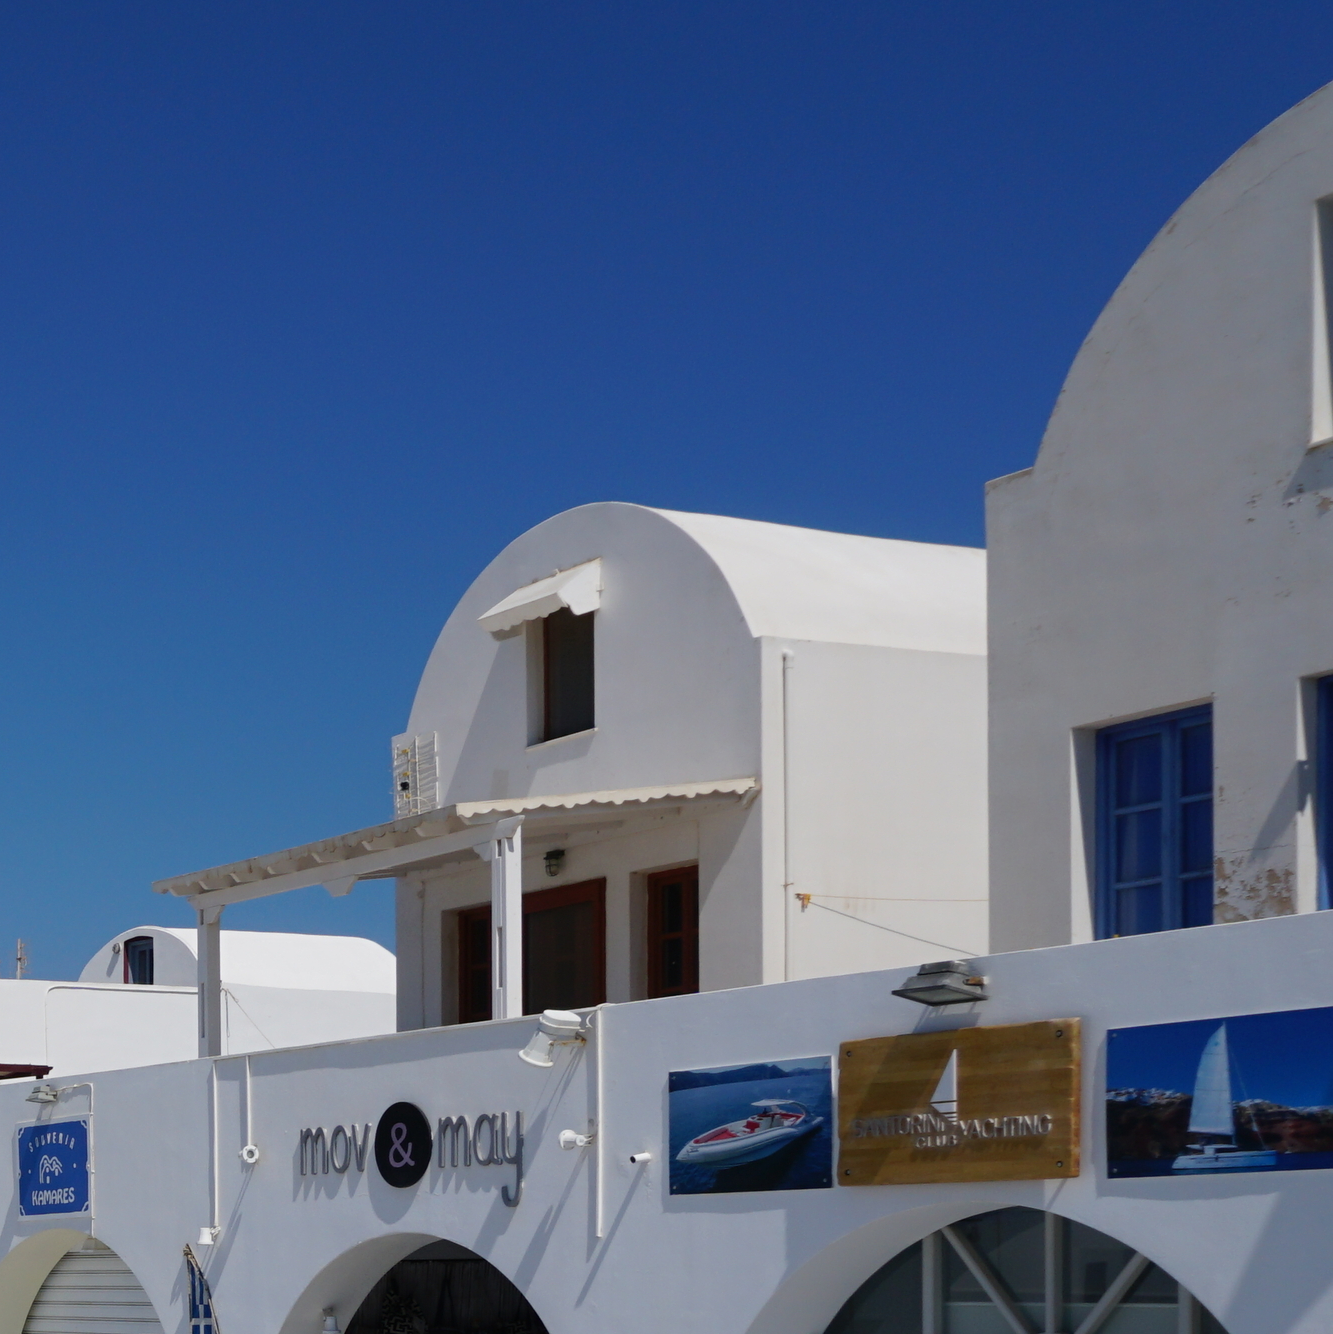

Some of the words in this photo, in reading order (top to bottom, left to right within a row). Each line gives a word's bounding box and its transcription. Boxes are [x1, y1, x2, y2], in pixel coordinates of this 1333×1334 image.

[959, 1114, 1053, 1138] YACHTING
[915, 1134, 958, 1148] CLUB
[300, 1123, 372, 1175] mov
[389, 1122, 416, 1168] &
[438, 1110, 524, 1207] may
[32, 1187, 75, 1206] KAMARES
